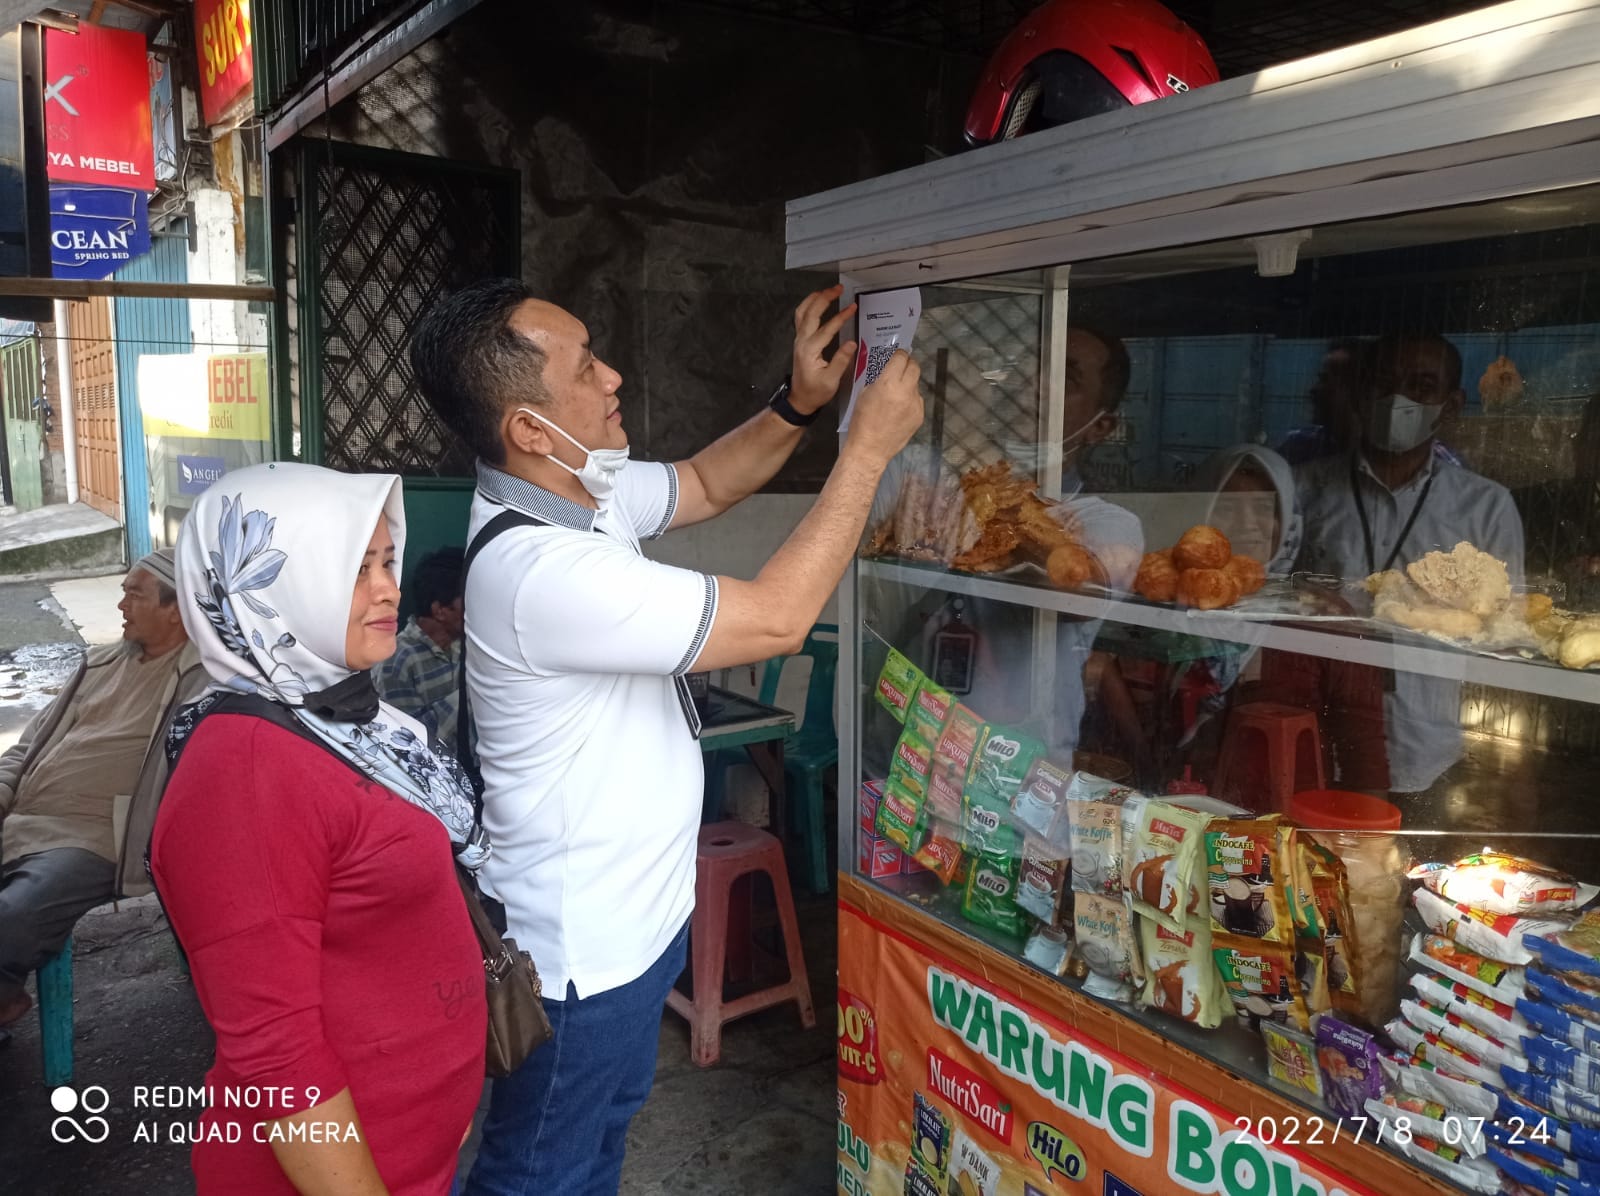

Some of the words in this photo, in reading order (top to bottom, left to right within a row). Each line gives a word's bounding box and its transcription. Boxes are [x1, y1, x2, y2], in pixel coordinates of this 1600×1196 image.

[202, 0, 251, 88] SUR
[48, 152, 74, 168] YA
[79, 156, 141, 176] MEBEL
[51, 229, 128, 250] CEAN
[74, 251, 109, 260] SPRING
[112, 251, 130, 260] BED
[192, 467, 220, 481] ANGEL
[987, 740, 1015, 757] MILO
[973, 811, 996, 828] MILO
[978, 874, 1006, 894] MILO
[840, 1043, 876, 1075] VIT-C
[931, 971, 1151, 1151] WARUNG
[930, 1055, 1006, 1137] NutriSari
